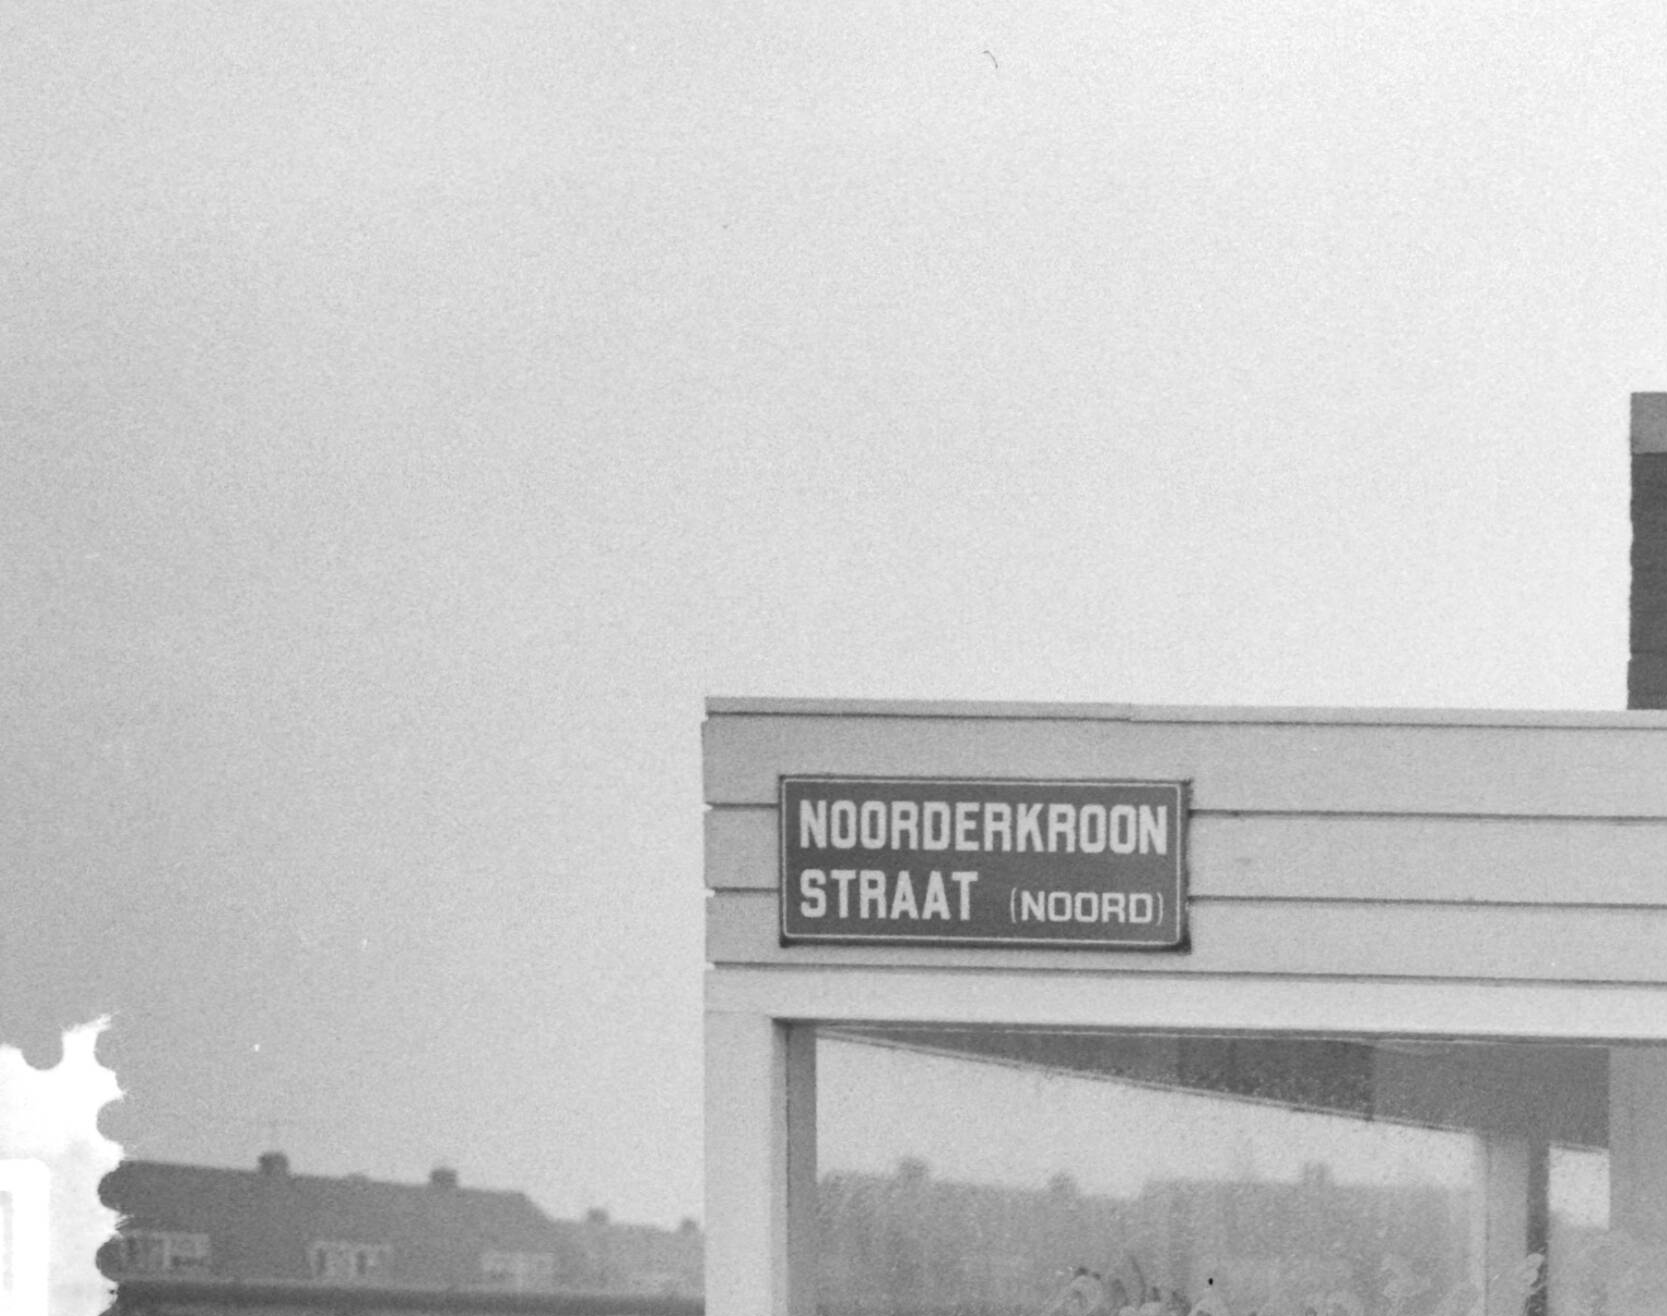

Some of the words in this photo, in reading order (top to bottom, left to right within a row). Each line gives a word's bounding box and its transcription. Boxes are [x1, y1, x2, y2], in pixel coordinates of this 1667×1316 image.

[799, 799, 1168, 854] NOORDERKROON
[799, 868, 979, 920] STRAAT
[1009, 887, 1165, 924] (NOORD)
